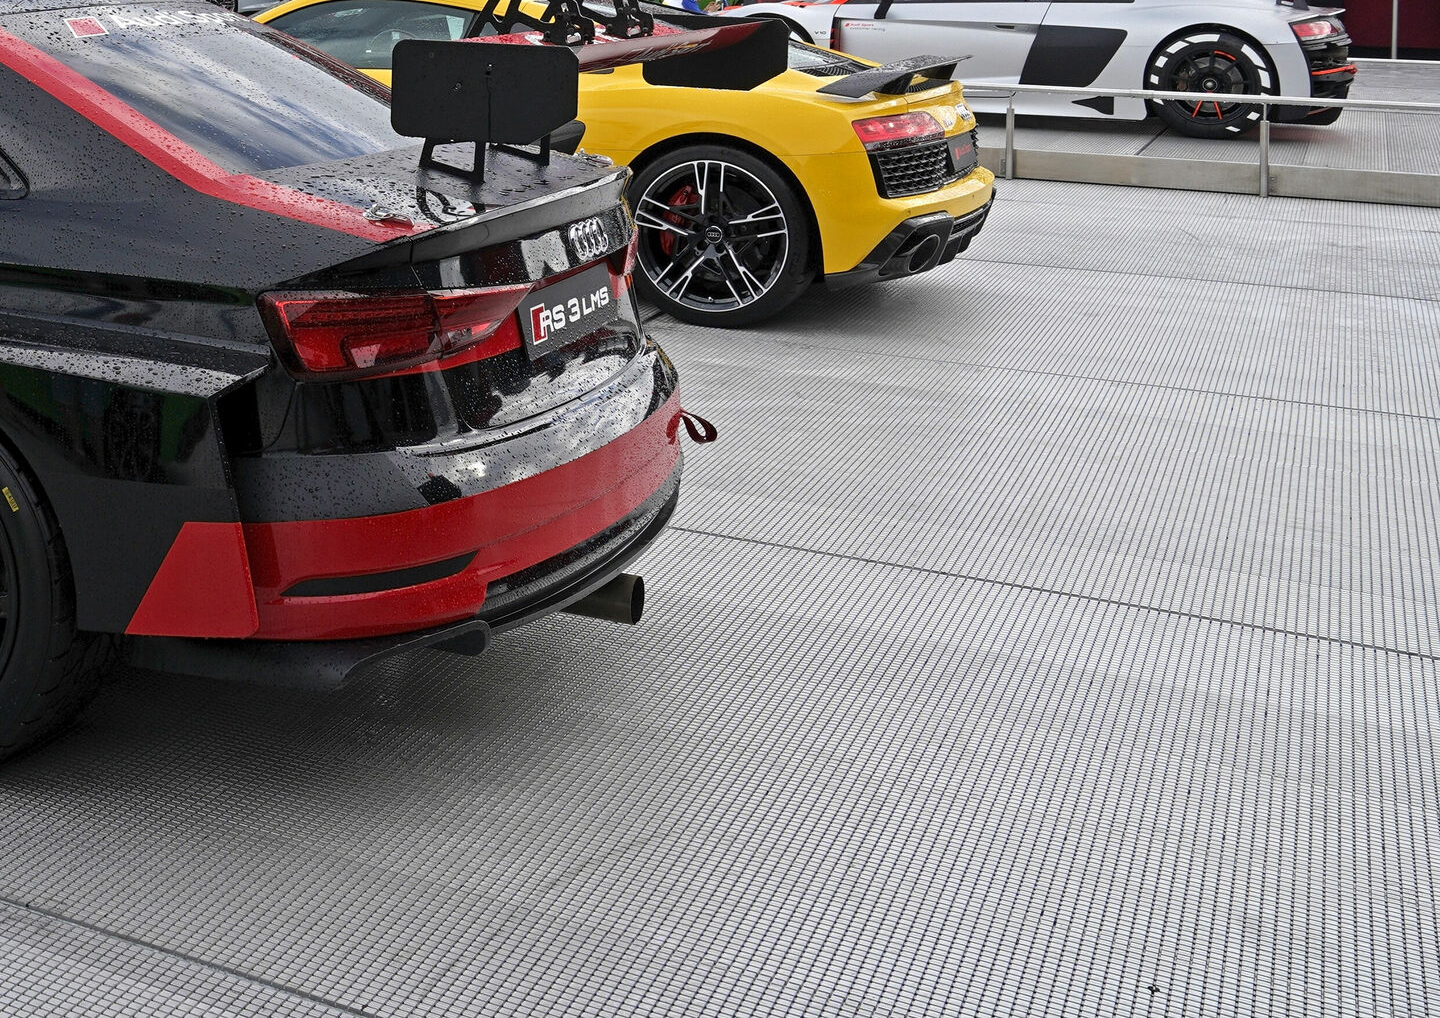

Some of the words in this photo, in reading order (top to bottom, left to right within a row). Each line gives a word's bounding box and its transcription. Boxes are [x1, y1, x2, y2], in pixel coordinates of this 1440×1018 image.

[538, 303, 566, 338] RS
[567, 297, 581, 323] 3
[581, 286, 610, 316] LMS
